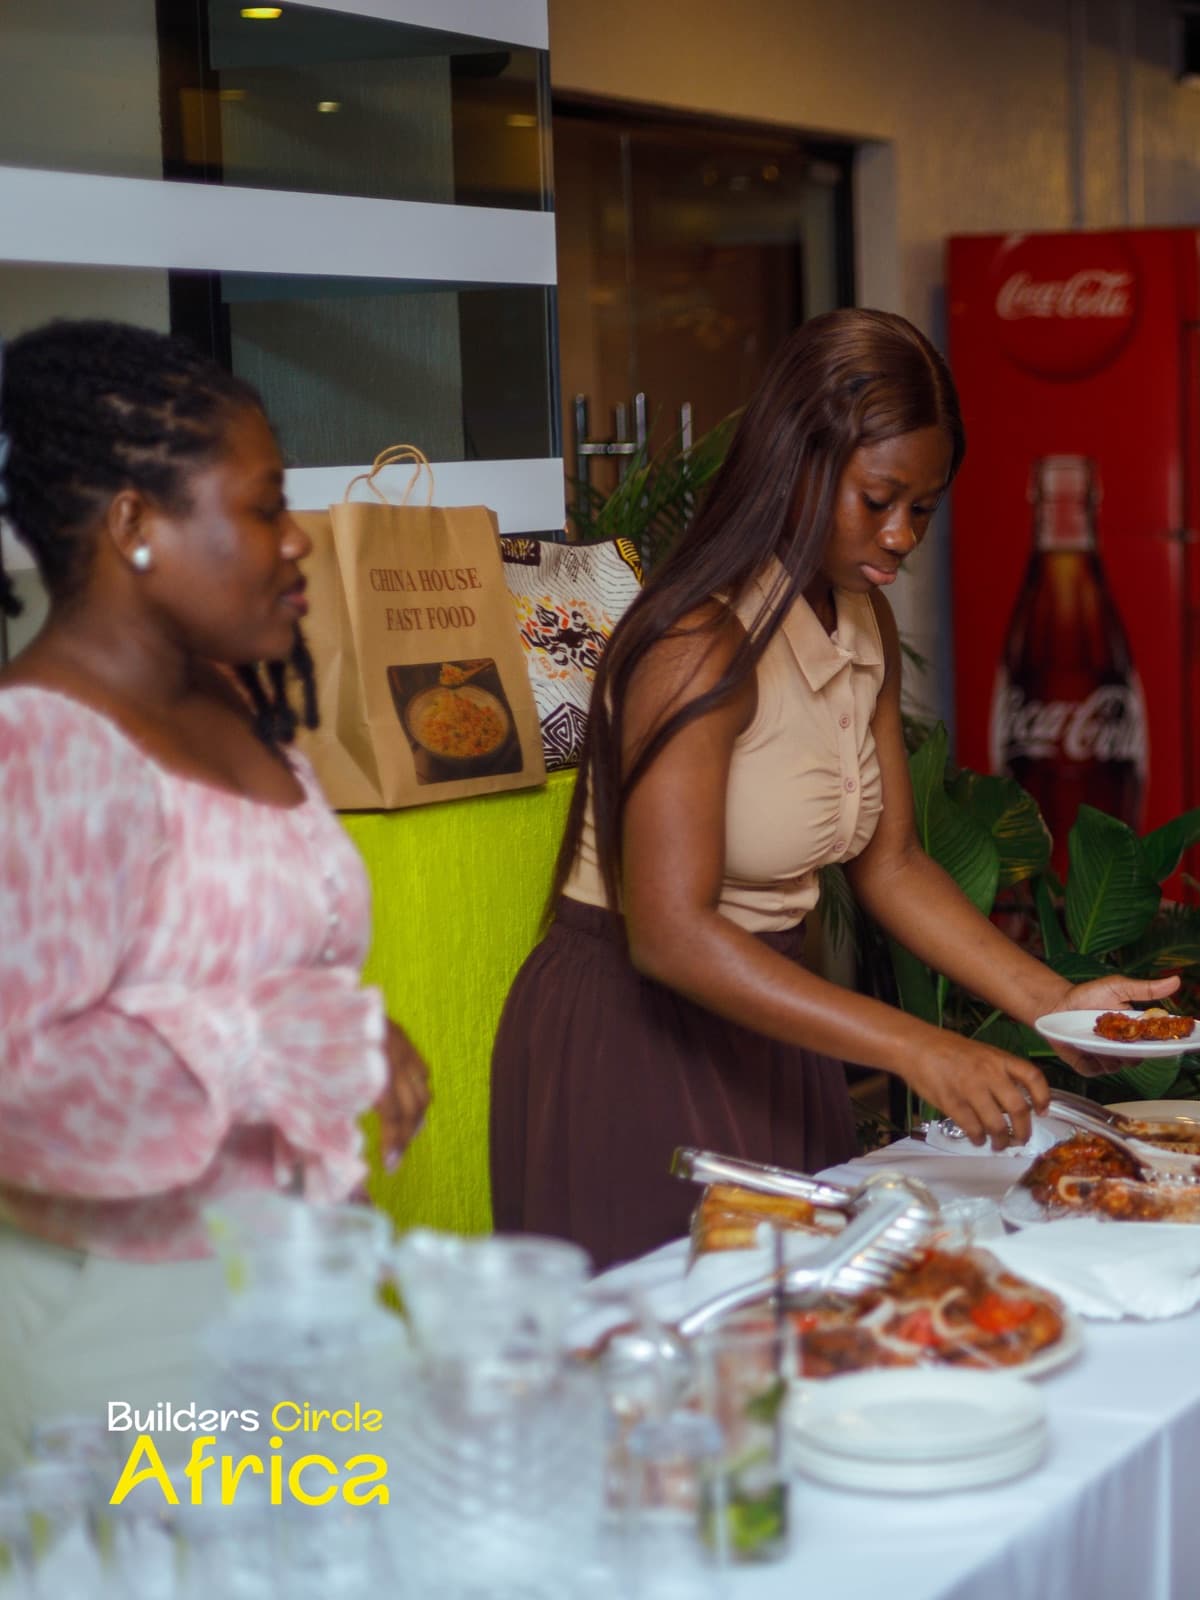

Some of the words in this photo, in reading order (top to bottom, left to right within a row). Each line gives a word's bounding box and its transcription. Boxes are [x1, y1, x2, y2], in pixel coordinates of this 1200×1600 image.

[369, 568, 417, 592] CHINA
[418, 568, 482, 591] HOUSE
[385, 607, 424, 631] FAST
[426, 606, 476, 630] FOOD
